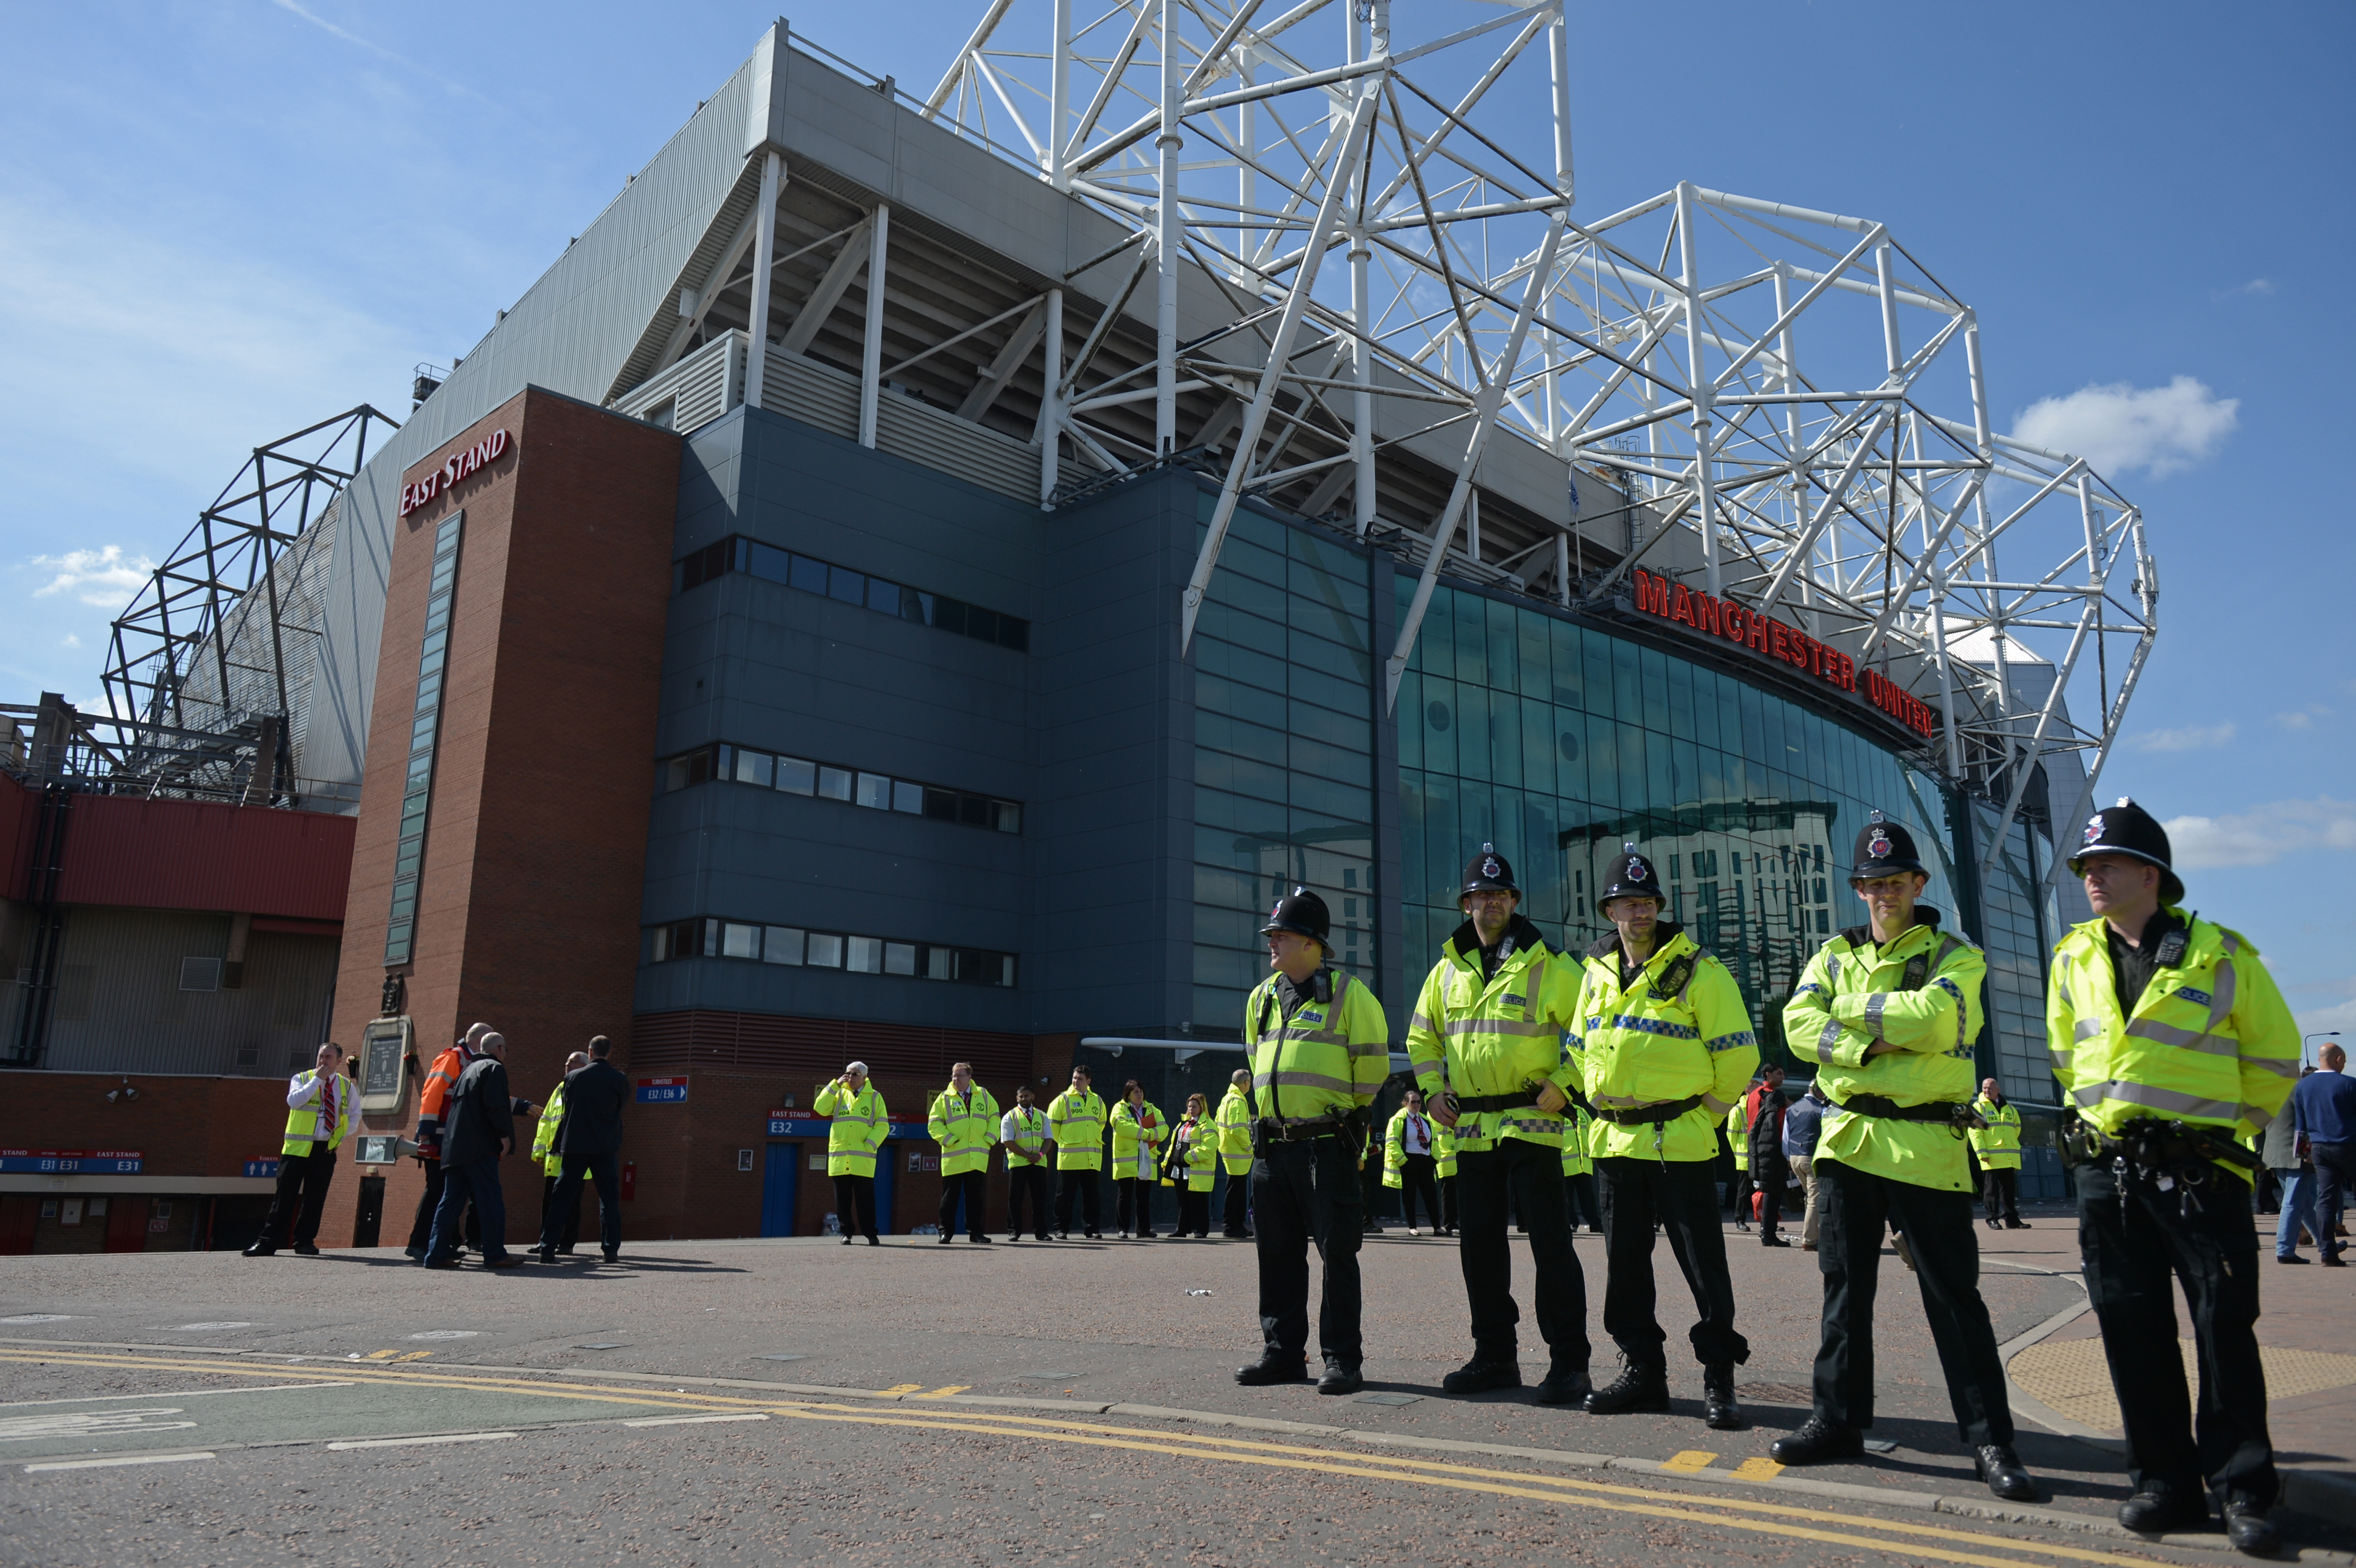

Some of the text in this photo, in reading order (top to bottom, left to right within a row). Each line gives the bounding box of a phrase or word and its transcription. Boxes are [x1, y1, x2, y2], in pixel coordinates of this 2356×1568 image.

[400, 429, 509, 517] EAST STAND
[1634, 570, 1931, 738] MANCHESTER UNITED
[1500, 996, 1525, 1006] POLICE
[1302, 1013, 1320, 1021] OLICE
[648, 1089, 674, 1099] E32 / E36
[771, 1122, 792, 1133] E32
[1376, 1132, 1386, 1141] EX
[41, 1160, 55, 1170] E31
[59, 1160, 78, 1170] E31
[117, 1161, 139, 1171] E31
